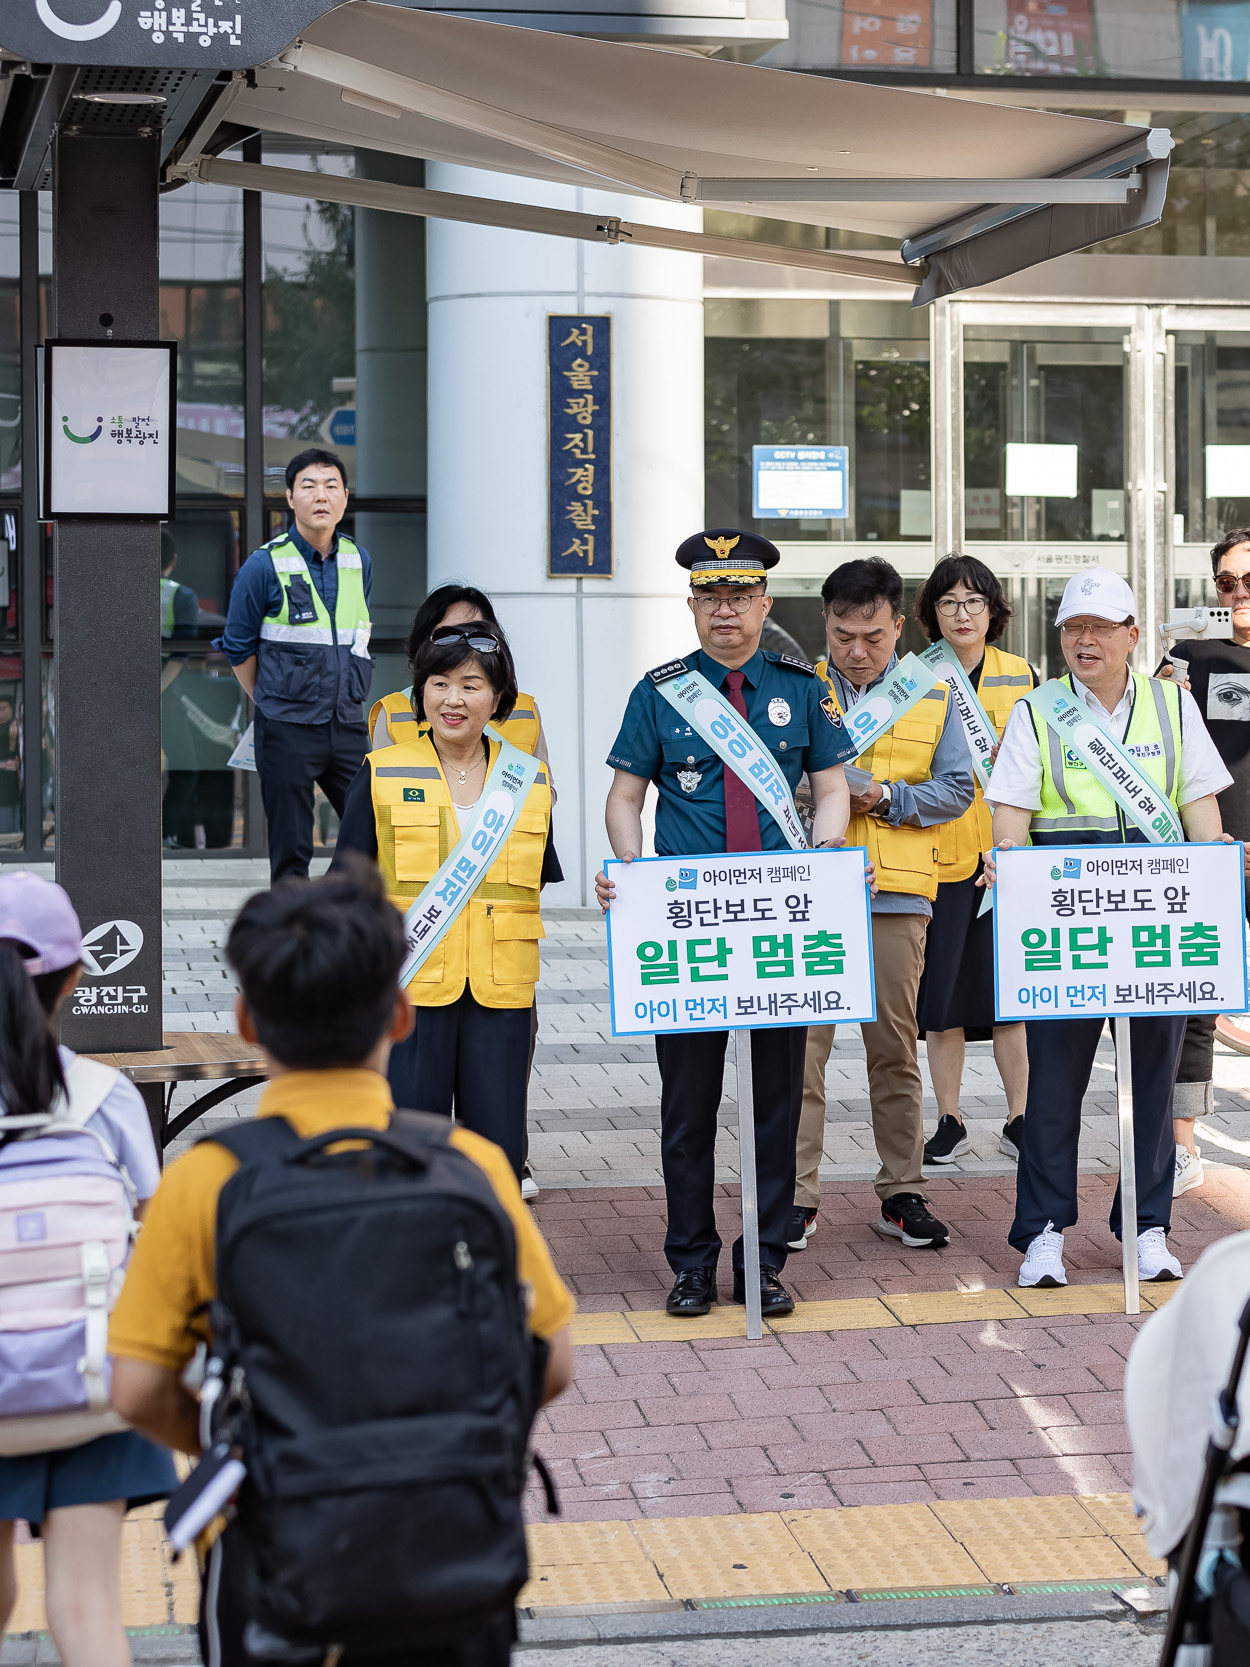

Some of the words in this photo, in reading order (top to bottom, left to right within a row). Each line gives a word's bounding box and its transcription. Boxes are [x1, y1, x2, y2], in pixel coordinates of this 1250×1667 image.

[138, 8, 241, 47] 행복광진
[110, 428, 159, 445] 행복광진
[560, 323, 599, 567] 서울광진경찰서
[1036, 553, 1100, 565] 서울광진경찰서
[710, 713, 754, 759] 아이
[748, 758, 787, 805] 먼저
[1087, 737, 1143, 799] 횡단보도
[1138, 796, 1157, 815] 앞
[471, 808, 505, 857] 아이
[435, 856, 478, 907] 먼저
[702, 867, 762, 887] 아이먼저
[766, 864, 811, 883] 캠페인
[1086, 858, 1143, 876] 아이먼저
[1147, 857, 1190, 875] 캠페인
[666, 897, 777, 929] 횡단보도
[784, 893, 813, 923] 앞
[1050, 887, 1156, 917] 횡단보도
[1163, 885, 1190, 914] 앞
[636, 937, 733, 986] 일단
[752, 930, 846, 979] 멈춤
[1020, 925, 1113, 971] 일단
[1131, 921, 1221, 968] 멈춤
[72, 1005, 149, 1015] GWANGJIN-GU
[73, 985, 148, 1005] 광진구
[634, 998, 678, 1024] 아이
[685, 995, 728, 1021] 먼저
[734, 990, 851, 1017] 보내주세요.
[1017, 985, 1058, 1009] 아이
[1066, 983, 1107, 1007] 먼저
[1113, 981, 1224, 1006] 보내주세요.
